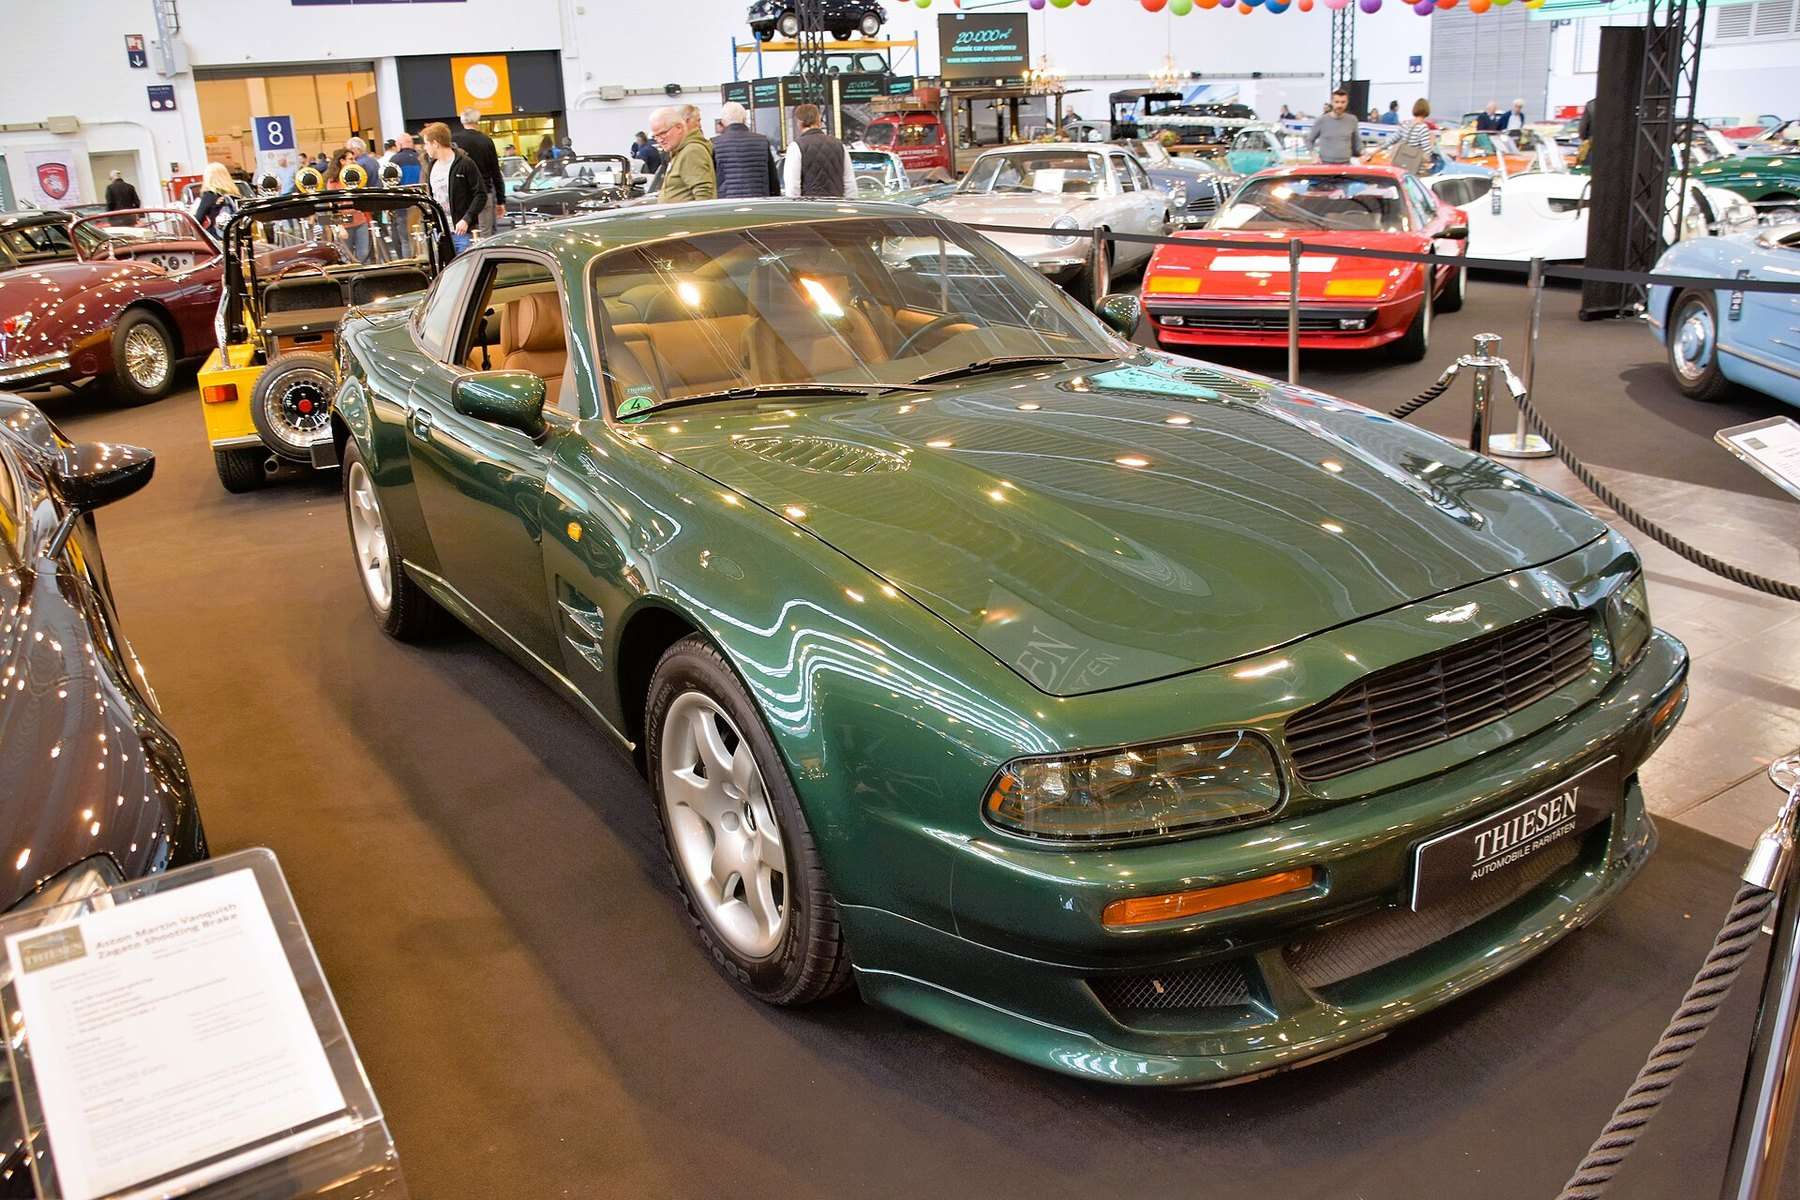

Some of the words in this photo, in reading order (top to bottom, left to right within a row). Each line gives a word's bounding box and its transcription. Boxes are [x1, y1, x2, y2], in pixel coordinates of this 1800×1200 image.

[267, 121, 284, 146] 8
[630, 399, 641, 409] 4
[1474, 786, 1580, 861] THIESEN
[1470, 845, 1532, 881] AUTOMOBILE
